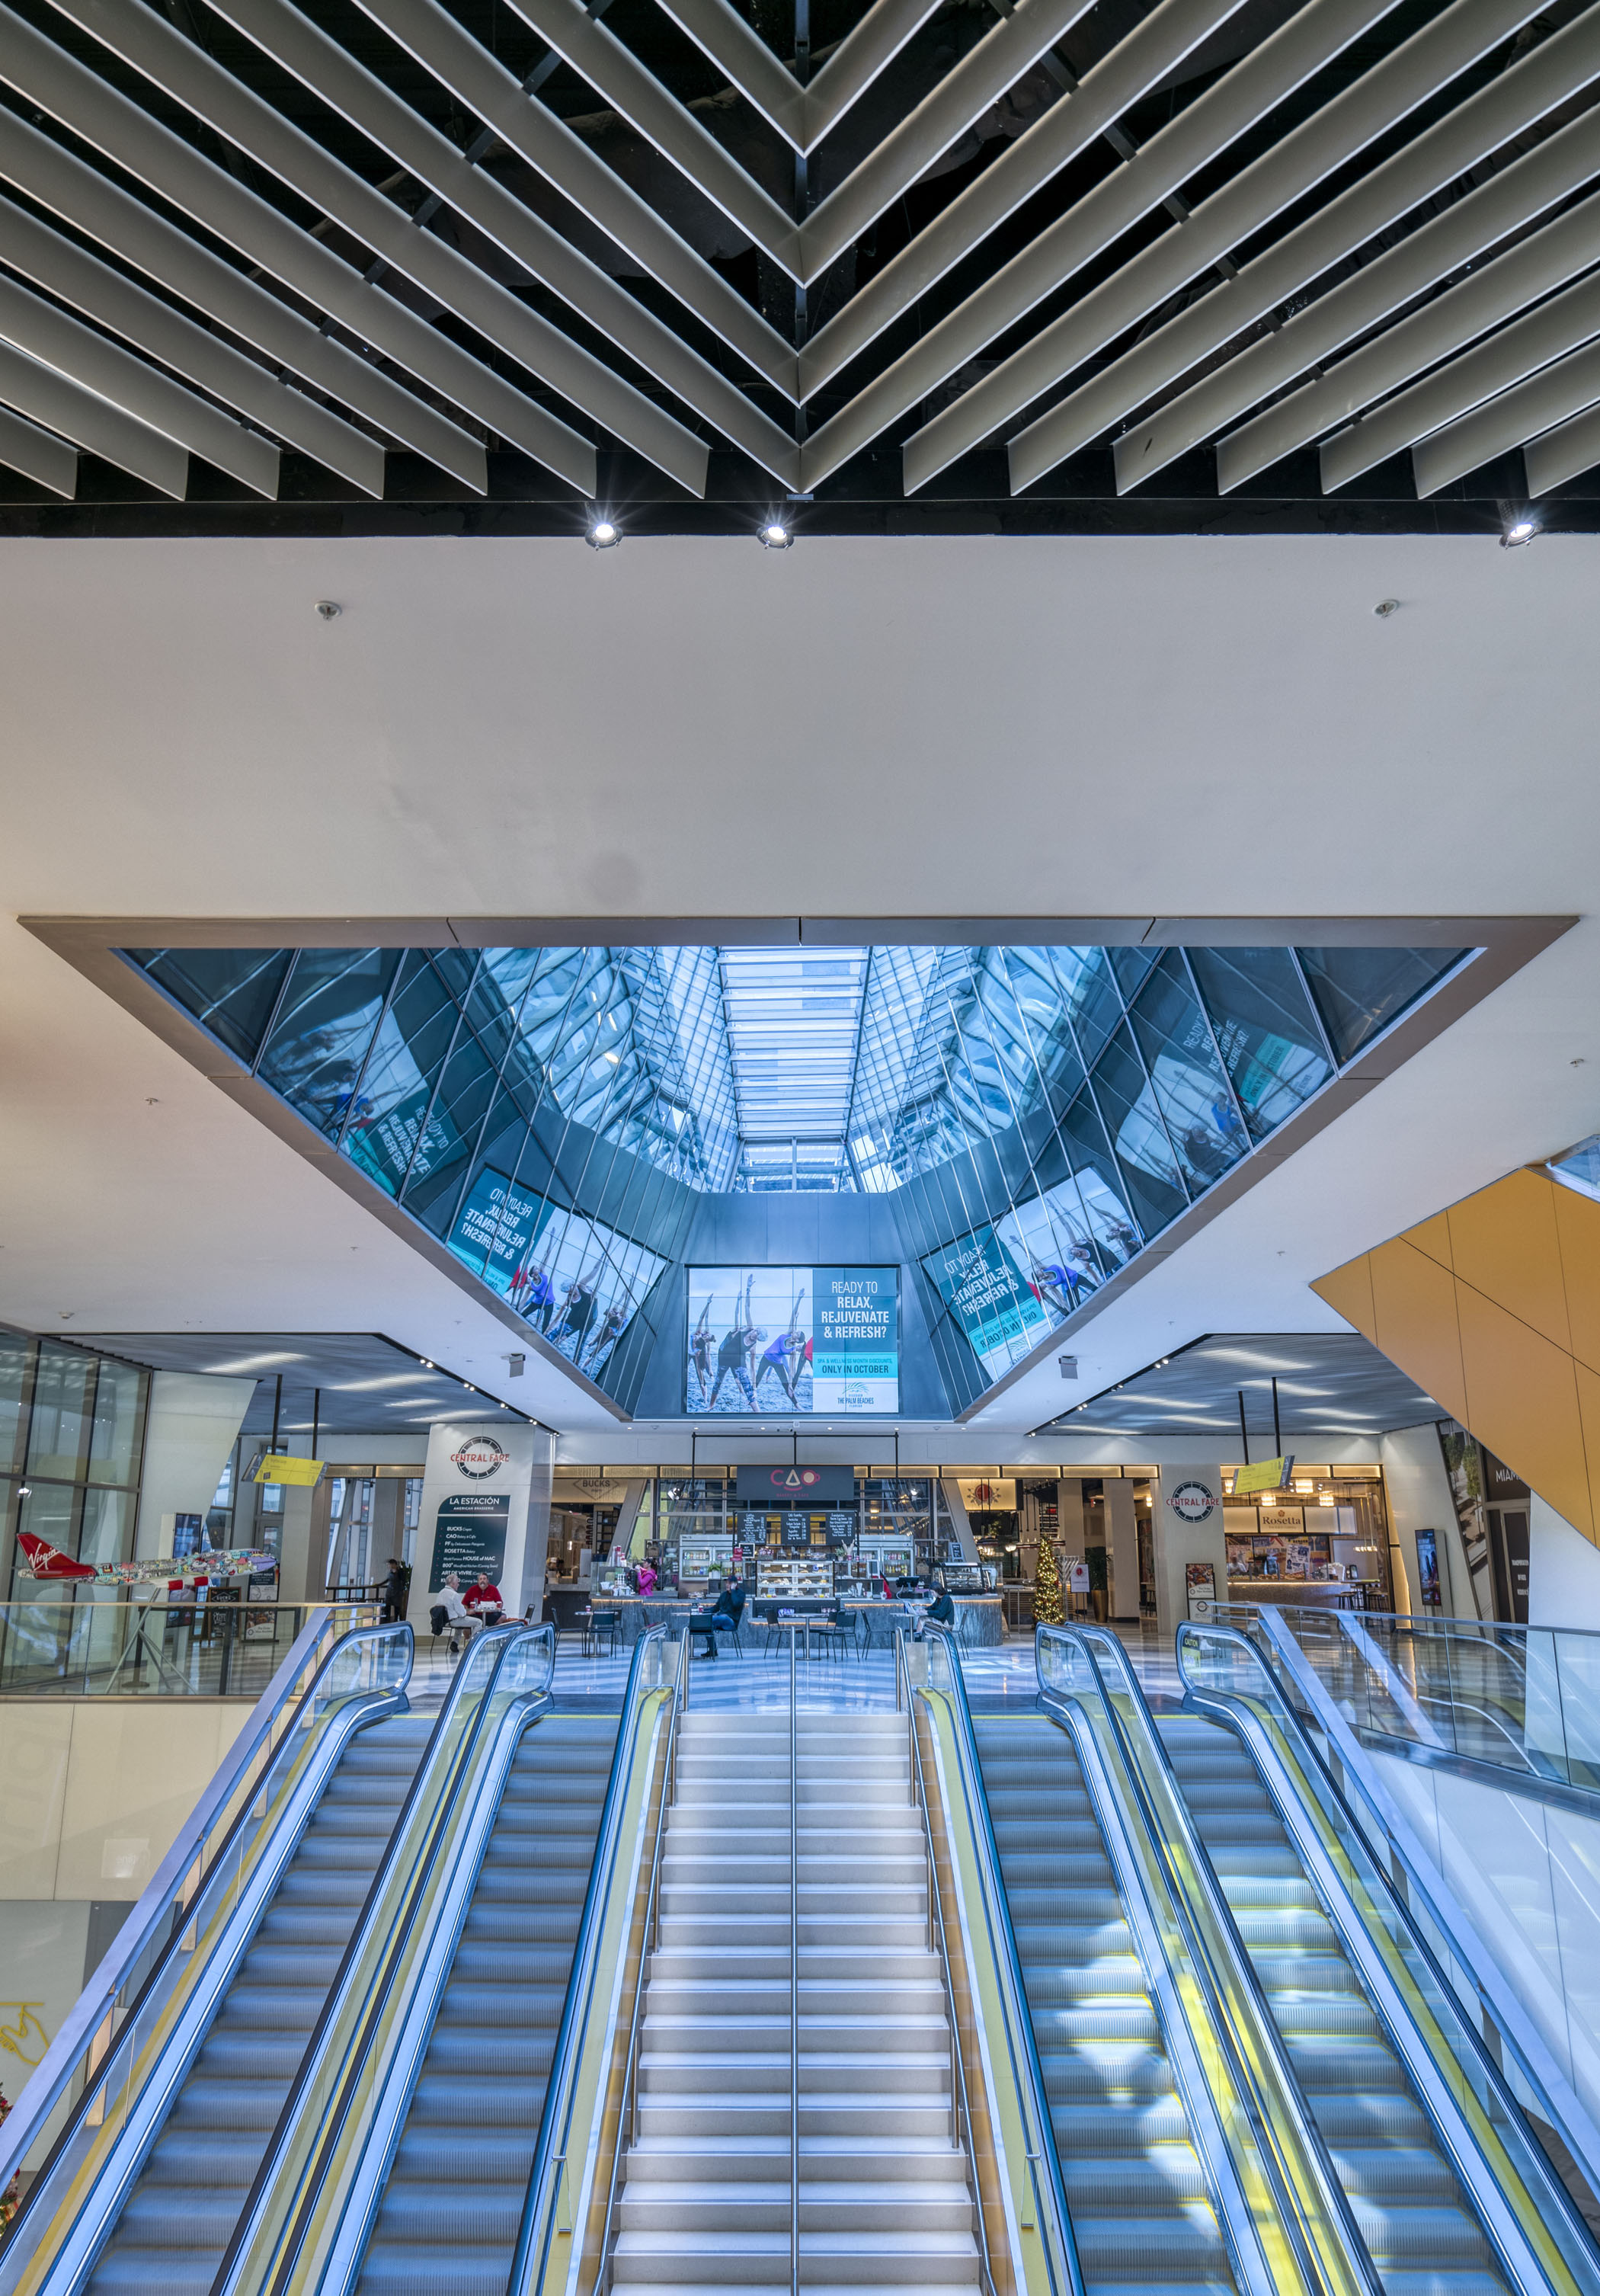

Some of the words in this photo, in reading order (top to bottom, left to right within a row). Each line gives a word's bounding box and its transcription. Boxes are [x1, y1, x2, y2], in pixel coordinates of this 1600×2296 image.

[831, 1281, 864, 1294] READY
[866, 1281, 878, 1294] TO
[837, 1296, 873, 1310] RELAX,
[821, 1311, 890, 1324] REJUVENATE
[824, 1326, 833, 1338] &
[835, 1326, 887, 1338] REFRESH?
[822, 1365, 842, 1373] ONLY
[844, 1365, 852, 1373] IN
[854, 1365, 889, 1373] OCTOBER
[450, 1453, 488, 1462] CENTRAL
[489, 1453, 510, 1462] FARE
[770, 1468, 821, 1486] CAO
[461, 1496, 500, 1505] ESTACIÓN
[1262, 1516, 1301, 1525] Rosetta
[28, 1542, 60, 1571] Virgin
